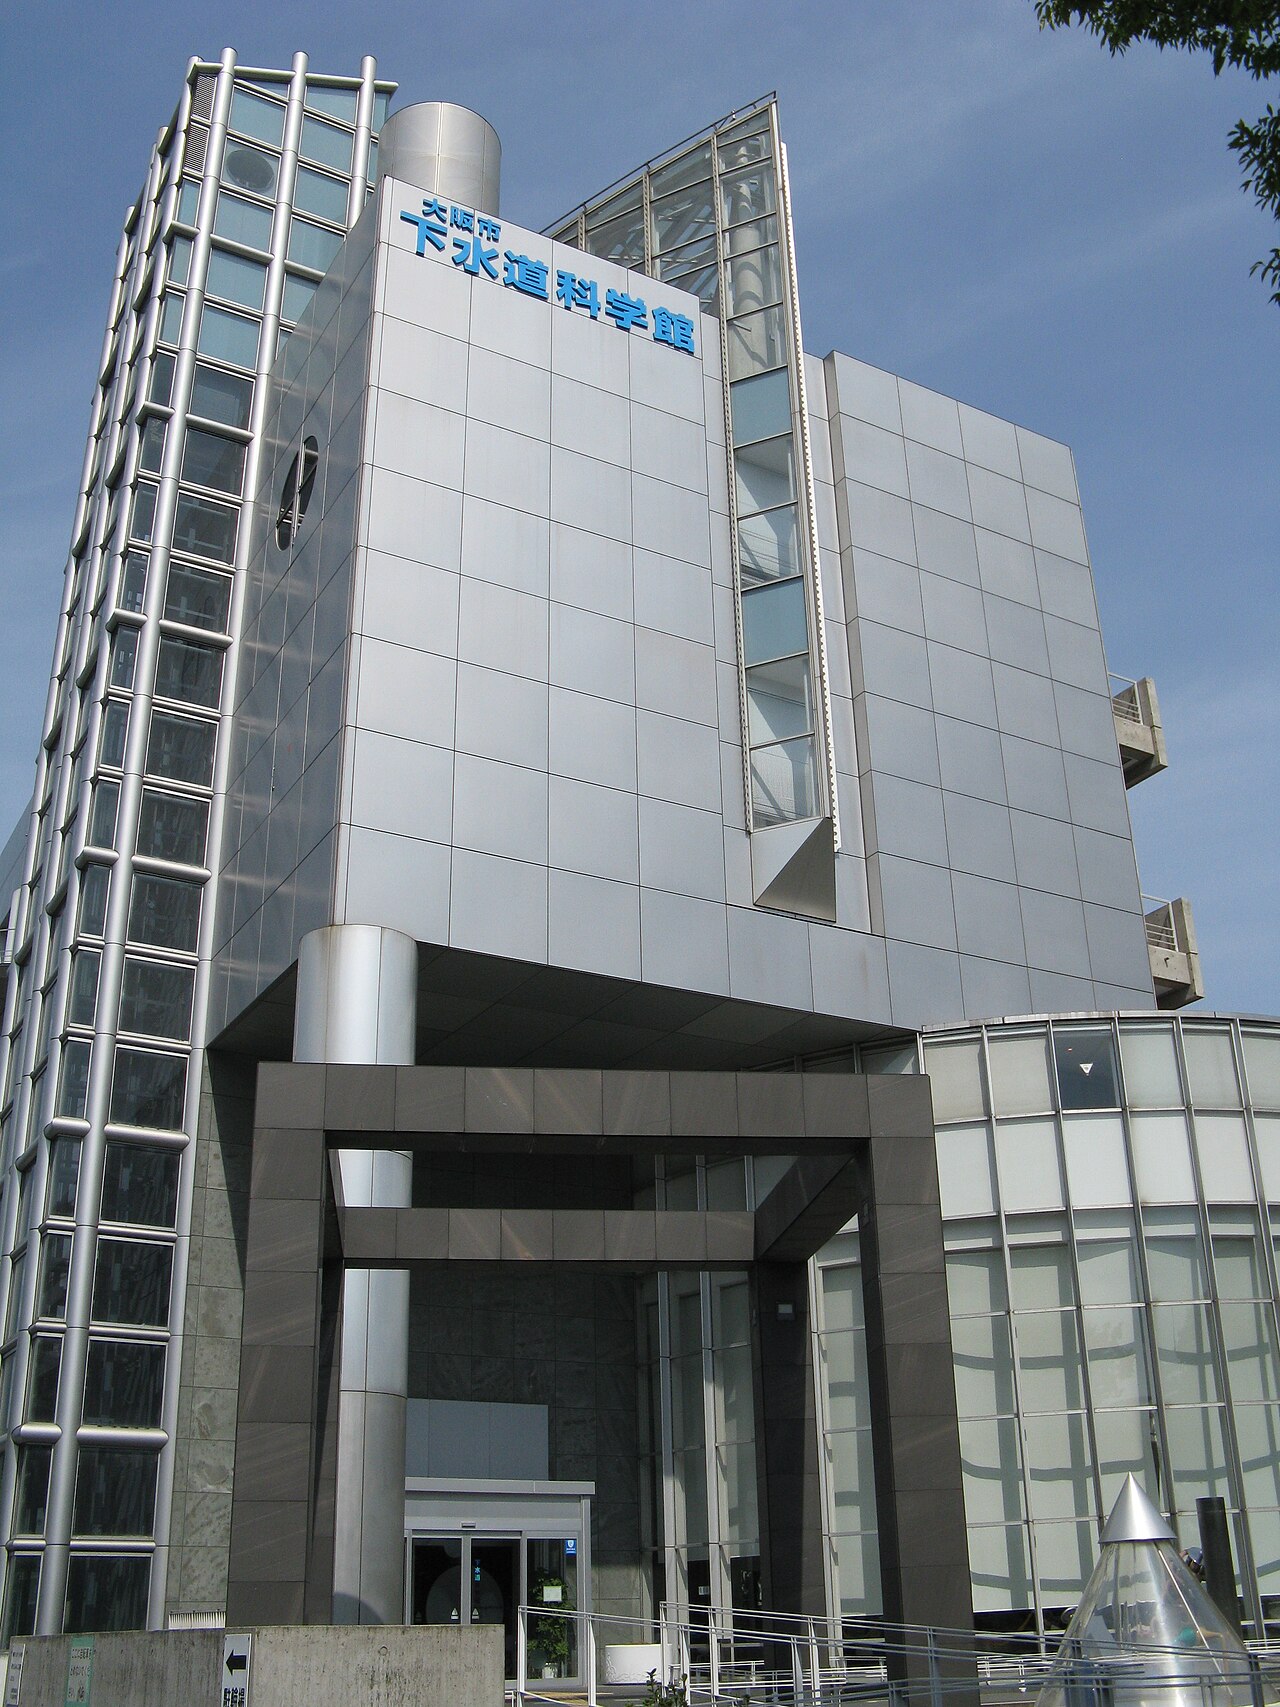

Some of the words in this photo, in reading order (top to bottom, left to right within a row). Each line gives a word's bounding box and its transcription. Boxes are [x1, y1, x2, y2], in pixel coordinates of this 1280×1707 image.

[422, 198, 501, 243] 大阪市
[400, 209, 695, 355] 下水道科学館
